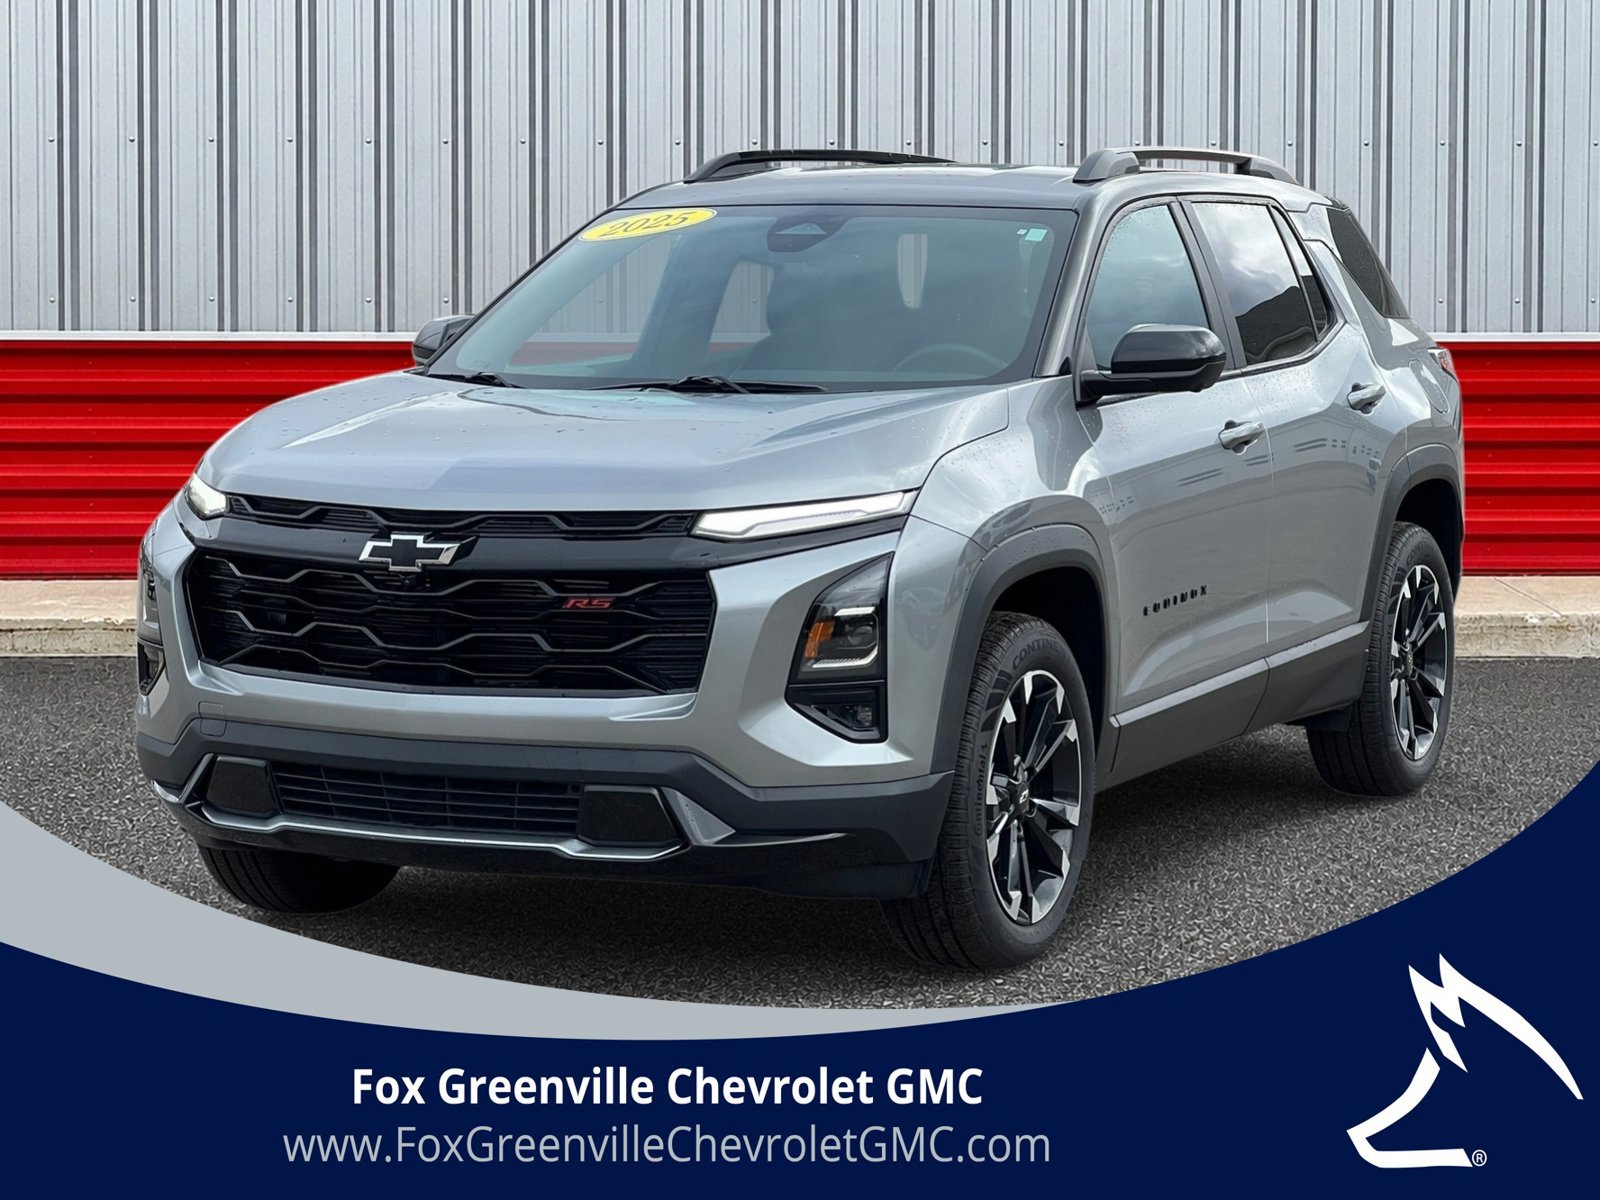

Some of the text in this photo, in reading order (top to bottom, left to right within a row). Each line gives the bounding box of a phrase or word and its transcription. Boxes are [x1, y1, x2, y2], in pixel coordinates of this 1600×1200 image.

[600, 211, 698, 237] 2025
[562, 597, 615, 609] RS
[1143, 585, 1207, 616] EQUINOX
